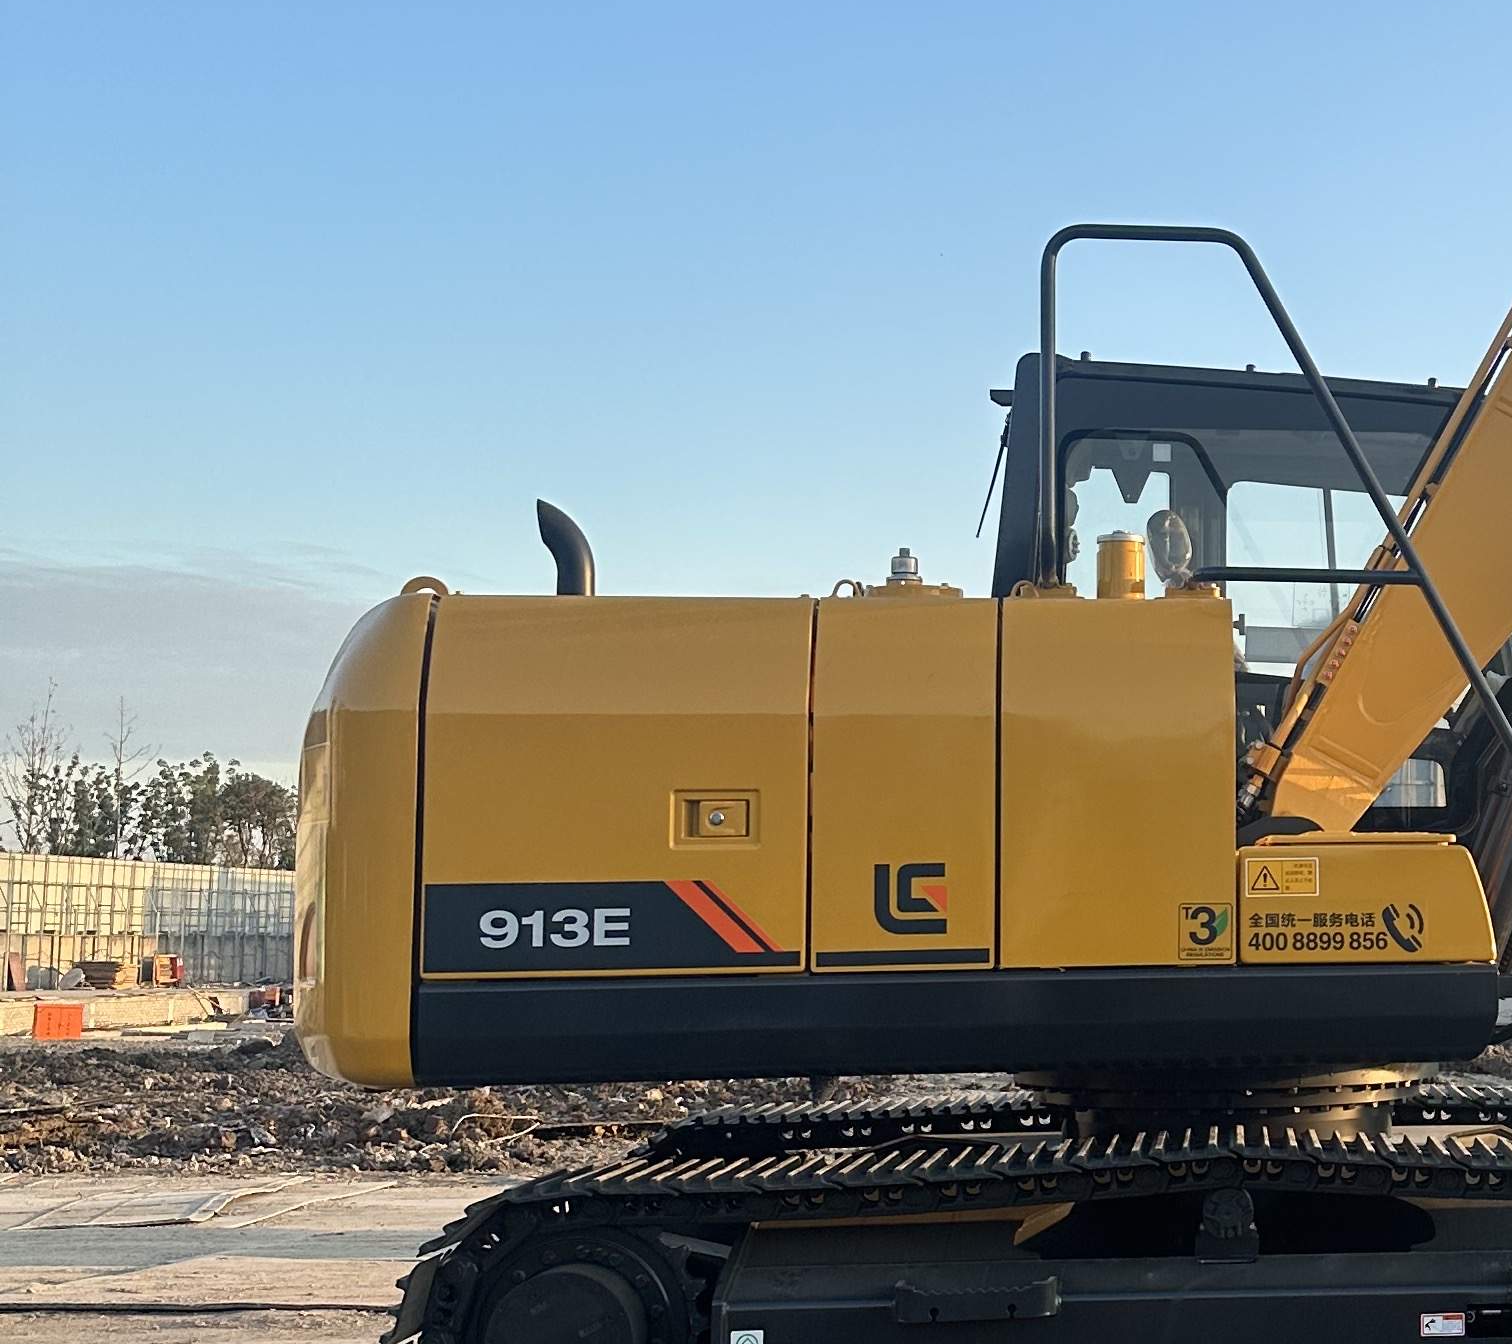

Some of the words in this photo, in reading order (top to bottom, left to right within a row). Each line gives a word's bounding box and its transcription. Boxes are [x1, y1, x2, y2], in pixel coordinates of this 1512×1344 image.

[478, 907, 631, 949] 913E
[1248, 912, 1377, 929] 全国统一服务电话
[1248, 931, 1288, 952] 400
[1292, 931, 1345, 951] 8899
[1349, 931, 1389, 951] 856
